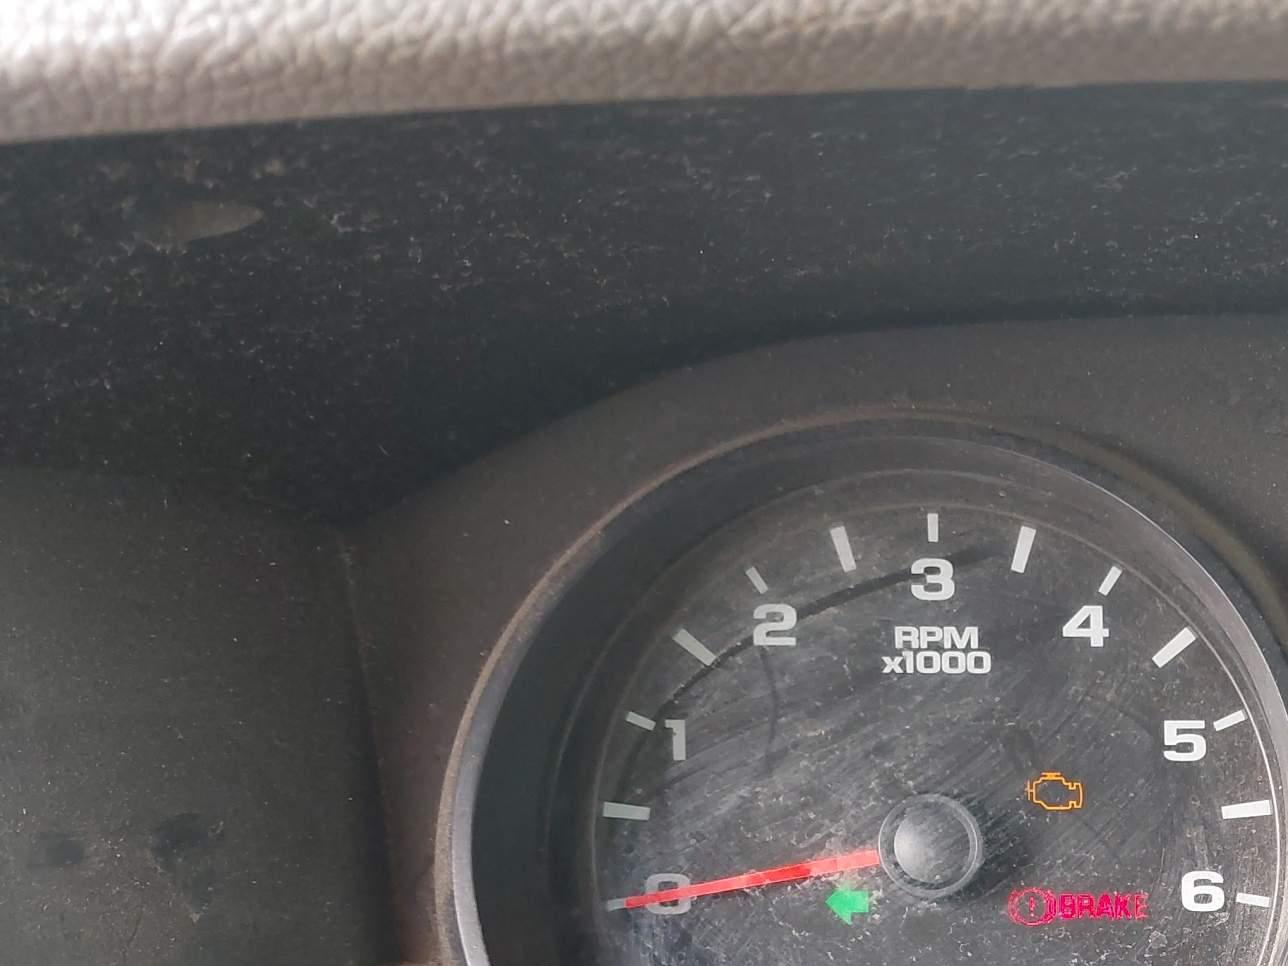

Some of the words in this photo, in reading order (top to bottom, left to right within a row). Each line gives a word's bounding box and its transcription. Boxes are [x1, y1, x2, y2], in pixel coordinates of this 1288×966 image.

[910, 558, 955, 601] 3
[753, 603, 797, 646] 2
[894, 626, 979, 648] RPM
[1062, 605, 1109, 647] 4
[882, 651, 991, 674] x1000
[665, 719, 686, 761] 1
[1163, 720, 1206, 762] 5
[645, 873, 690, 915] 0
[1058, 893, 1148, 920] BRAKE
[1181, 871, 1224, 912] 6
